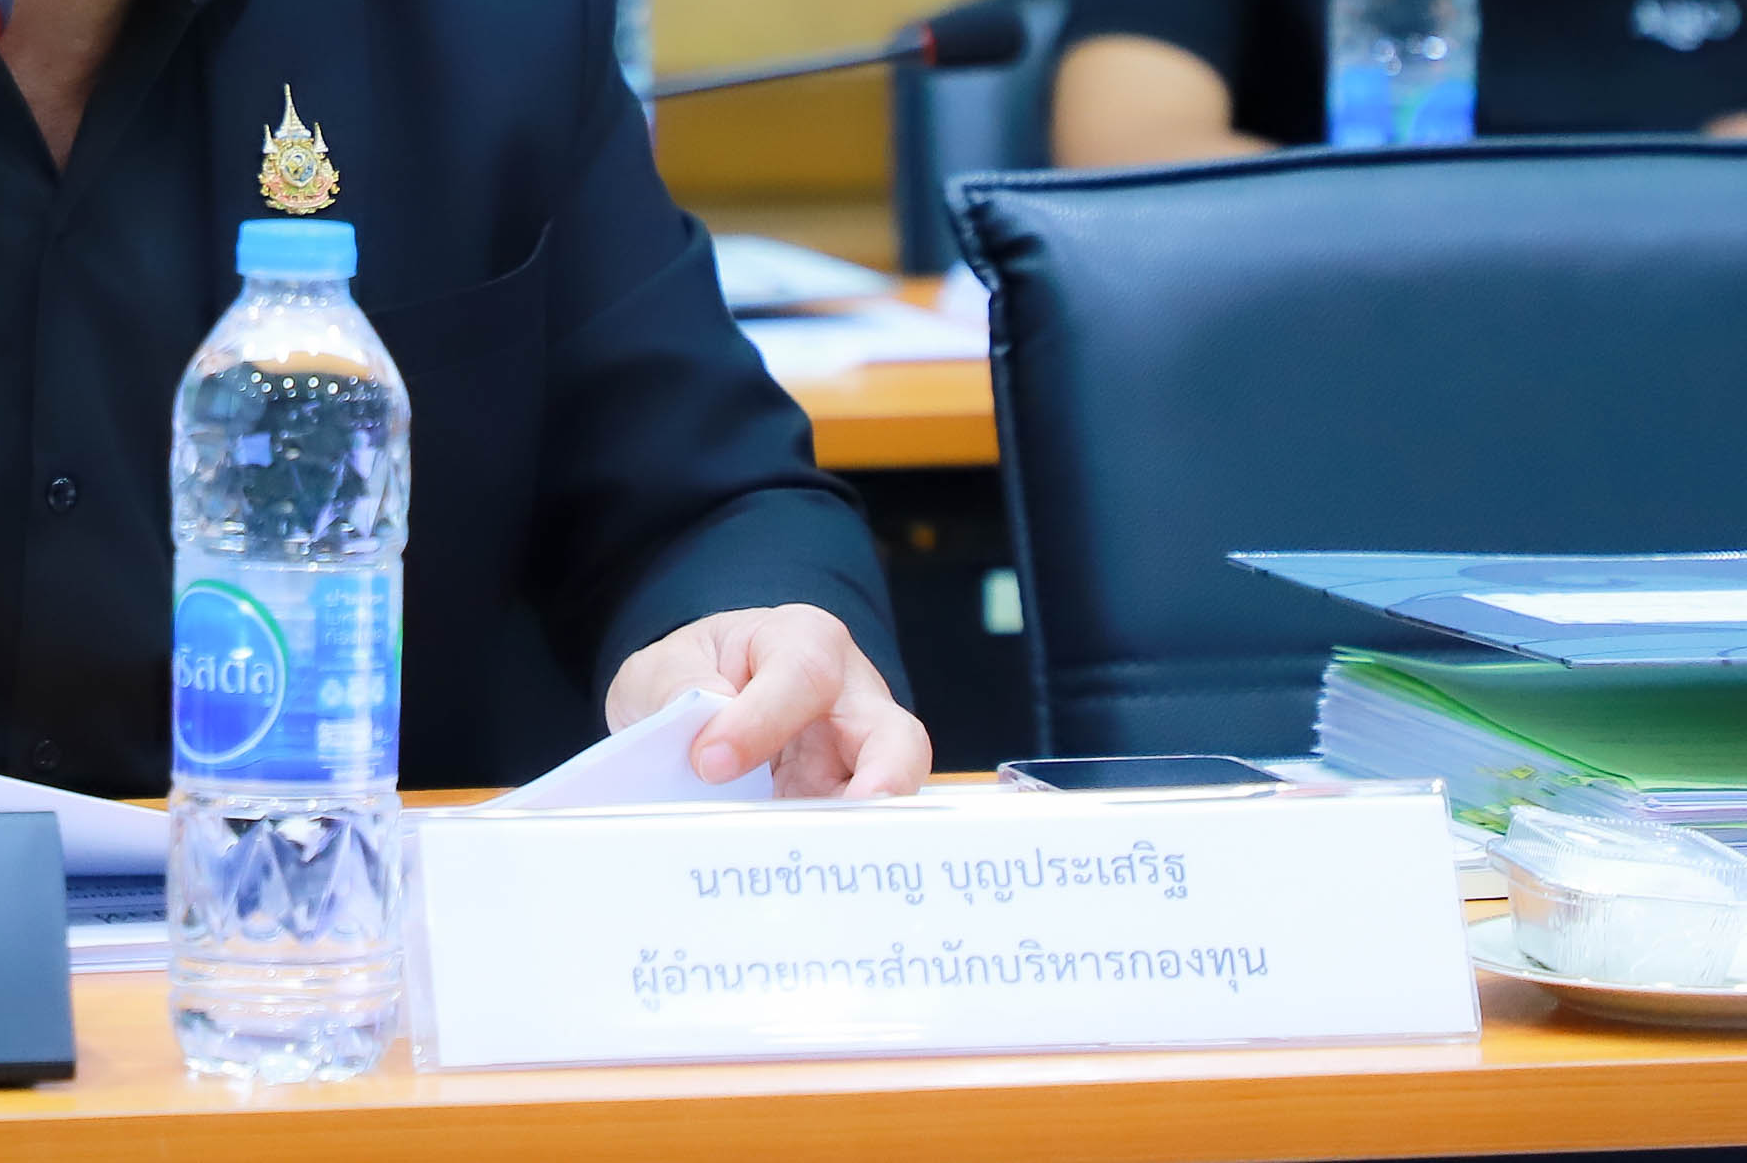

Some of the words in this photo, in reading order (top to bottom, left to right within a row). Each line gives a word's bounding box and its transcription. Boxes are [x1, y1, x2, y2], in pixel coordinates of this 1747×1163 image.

[689, 849, 923, 906] นายชำนาญ
[941, 840, 1188, 907] บุญประเสริฐ
[632, 938, 1268, 1013] ผู้อำนวยการสำนักบริหารกองทุน
